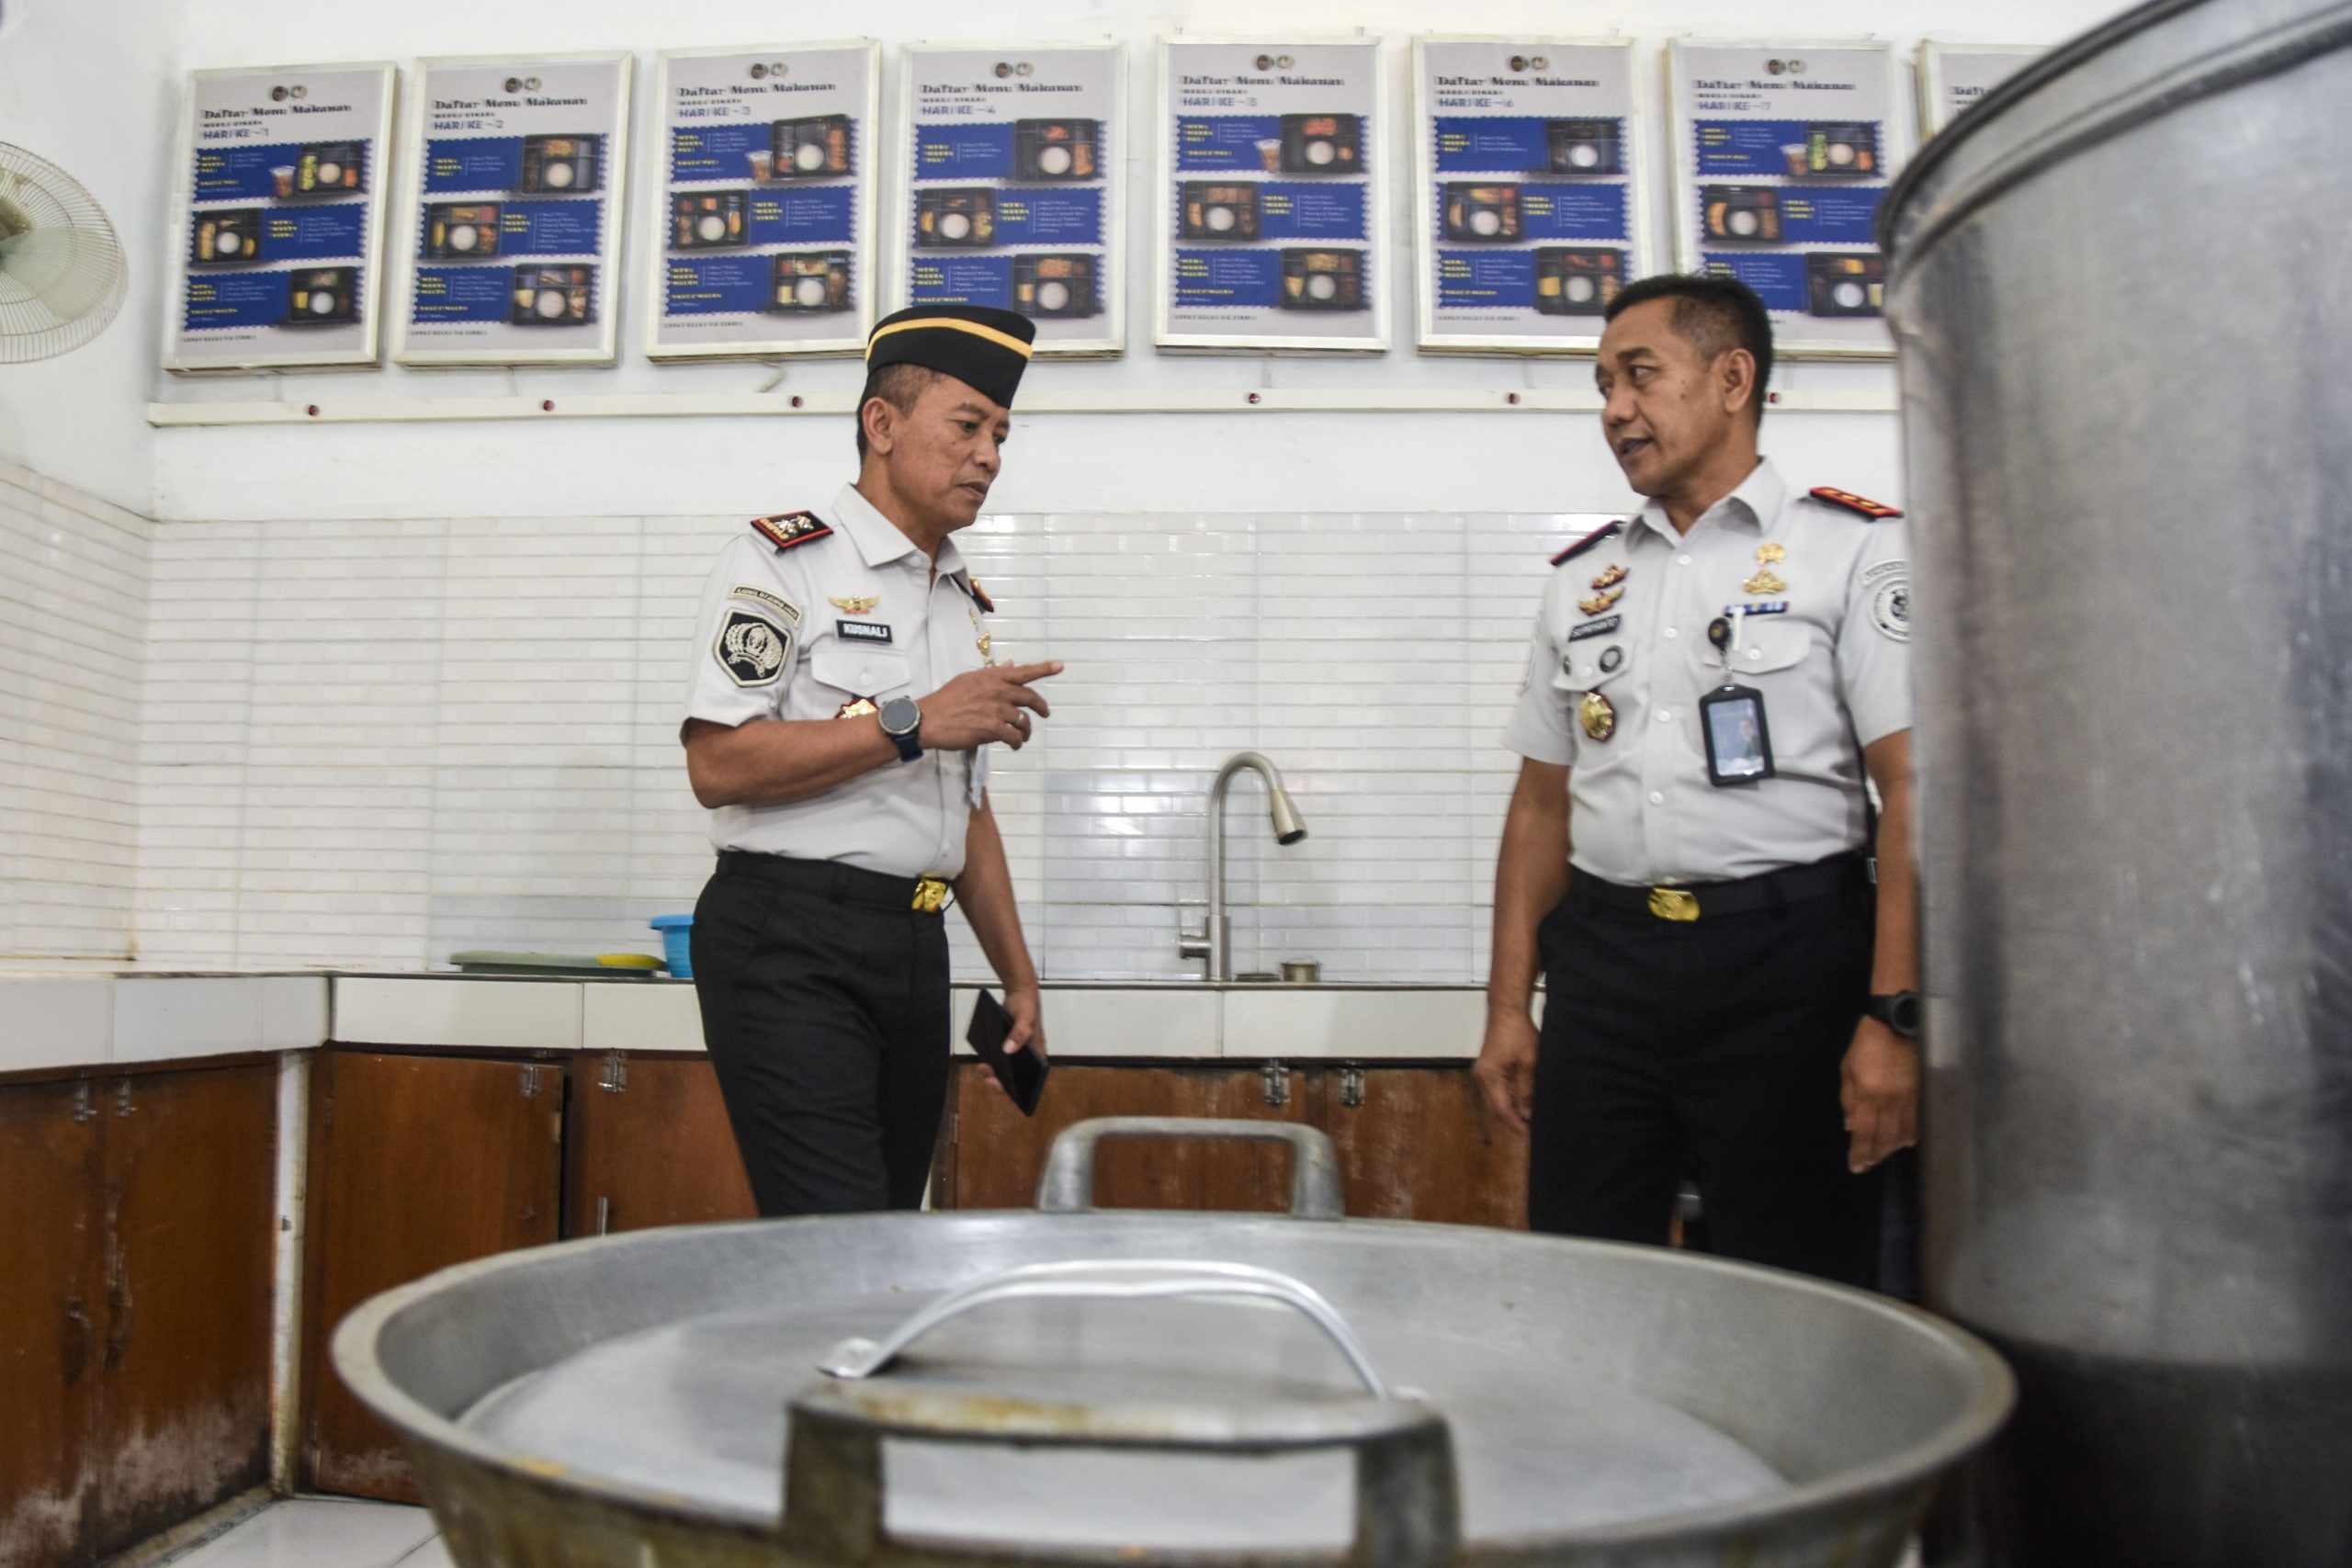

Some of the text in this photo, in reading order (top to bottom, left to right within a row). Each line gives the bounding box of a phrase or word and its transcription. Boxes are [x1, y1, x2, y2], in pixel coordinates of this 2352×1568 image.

[1182, 76, 1345, 85] Daftar Menu Makanan
[1438, 76, 1600, 86] Daftar Menu Makanan
[680, 88, 726, 97] Daftar
[774, 84, 836, 93] Makanan
[922, 84, 1082, 94] Daftar Menu Makanan
[435, 97, 587, 109] Daftar Menu Makanan
[205, 105, 352, 118] Daftar Menu Makanan
[714, 107, 729, 116] KE
[468, 120, 482, 130] KE
[843, 623, 888, 637] KUSNALI
